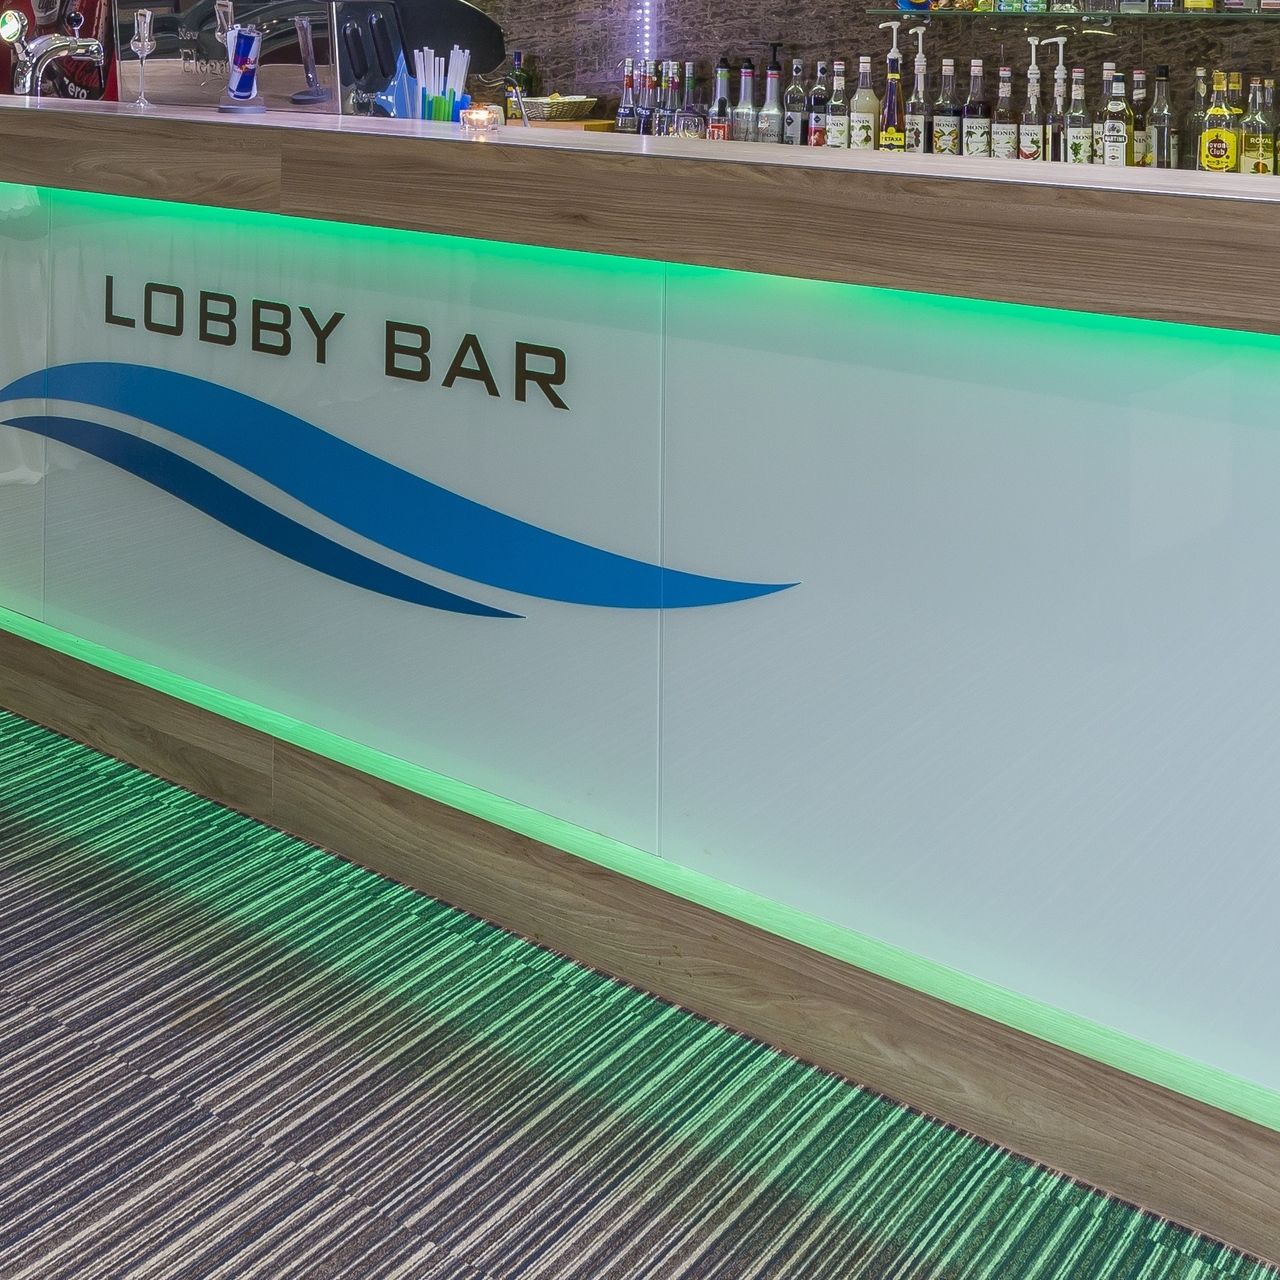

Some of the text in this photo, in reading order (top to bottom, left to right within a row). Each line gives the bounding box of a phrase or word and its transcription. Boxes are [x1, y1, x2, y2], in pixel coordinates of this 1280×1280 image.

[1250, 136, 1272, 144] ROYAL
[105, 274, 570, 411] LOBBY BAR
